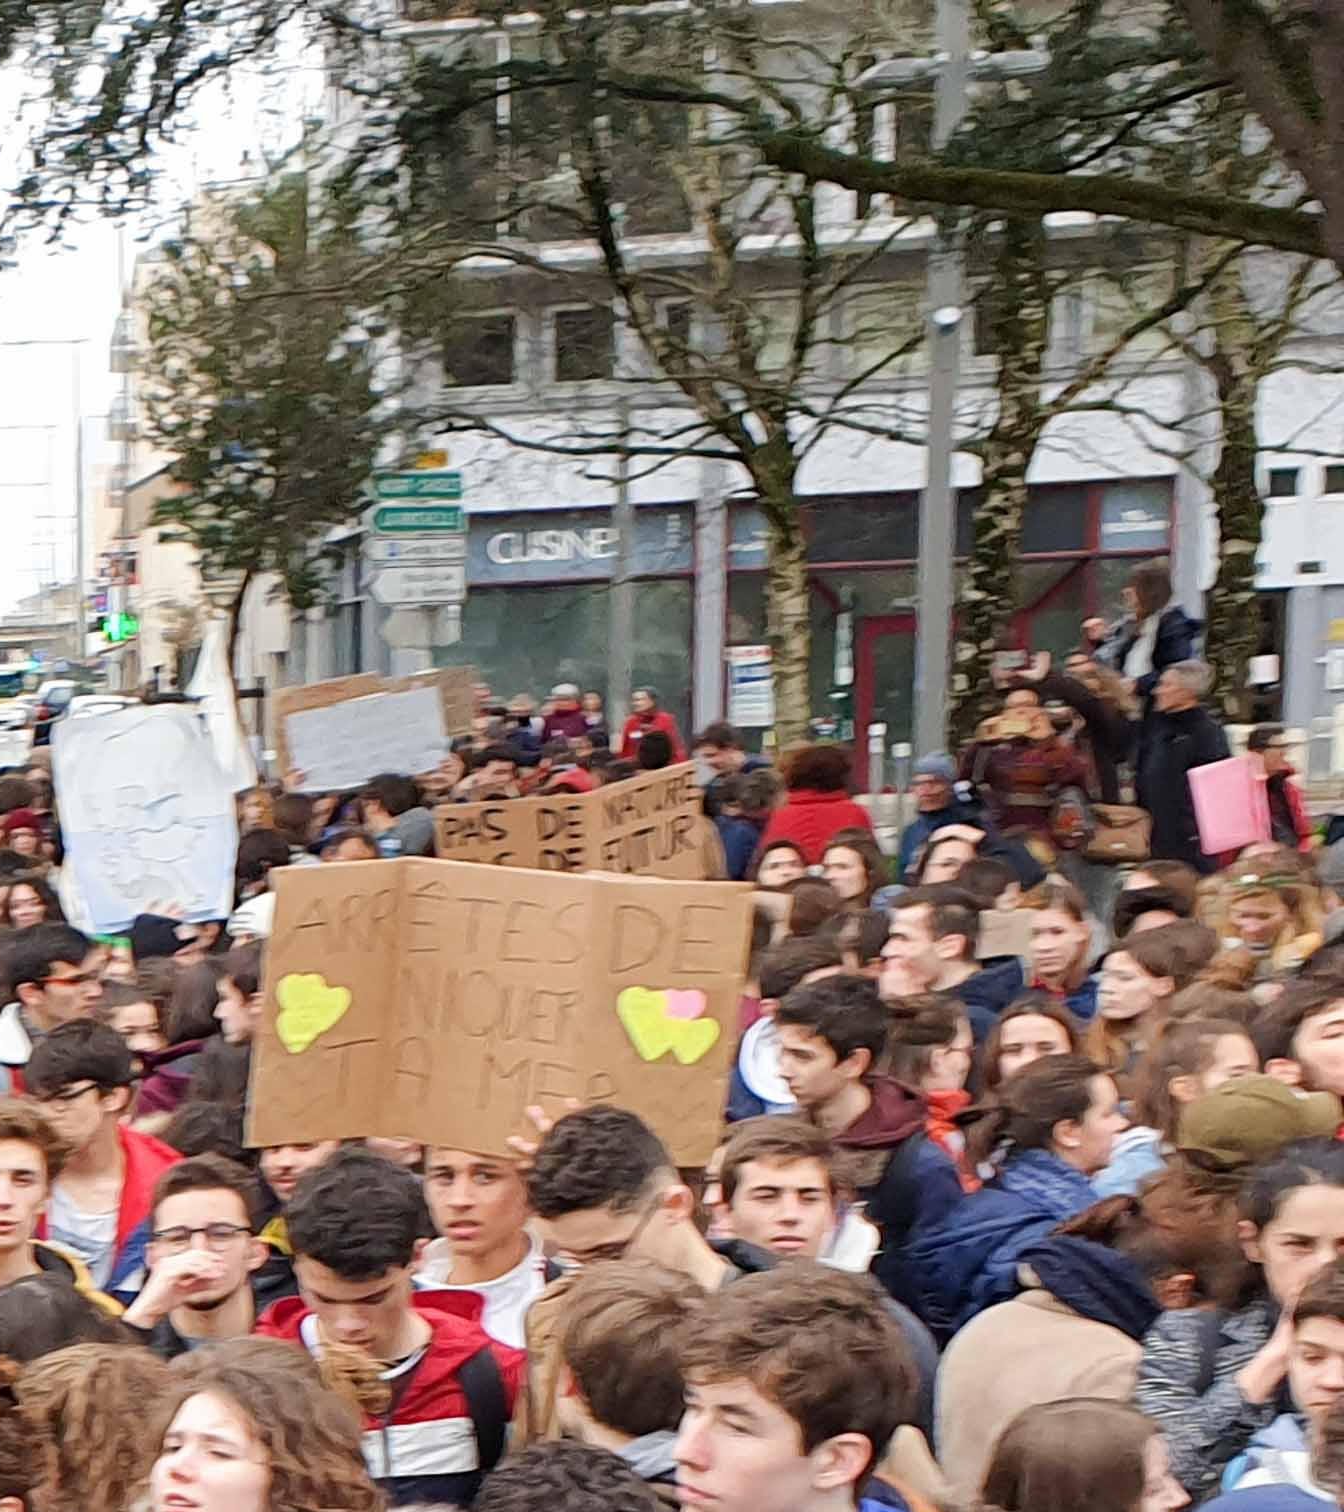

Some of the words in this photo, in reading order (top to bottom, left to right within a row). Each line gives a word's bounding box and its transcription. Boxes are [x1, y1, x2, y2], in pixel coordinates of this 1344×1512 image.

[444, 807, 509, 849] PAS
[536, 804, 586, 842] DE
[603, 769, 697, 829] NATURE
[601, 813, 699, 874] FUTUR
[611, 903, 727, 975] DE
[324, 1034, 434, 1106] TA
